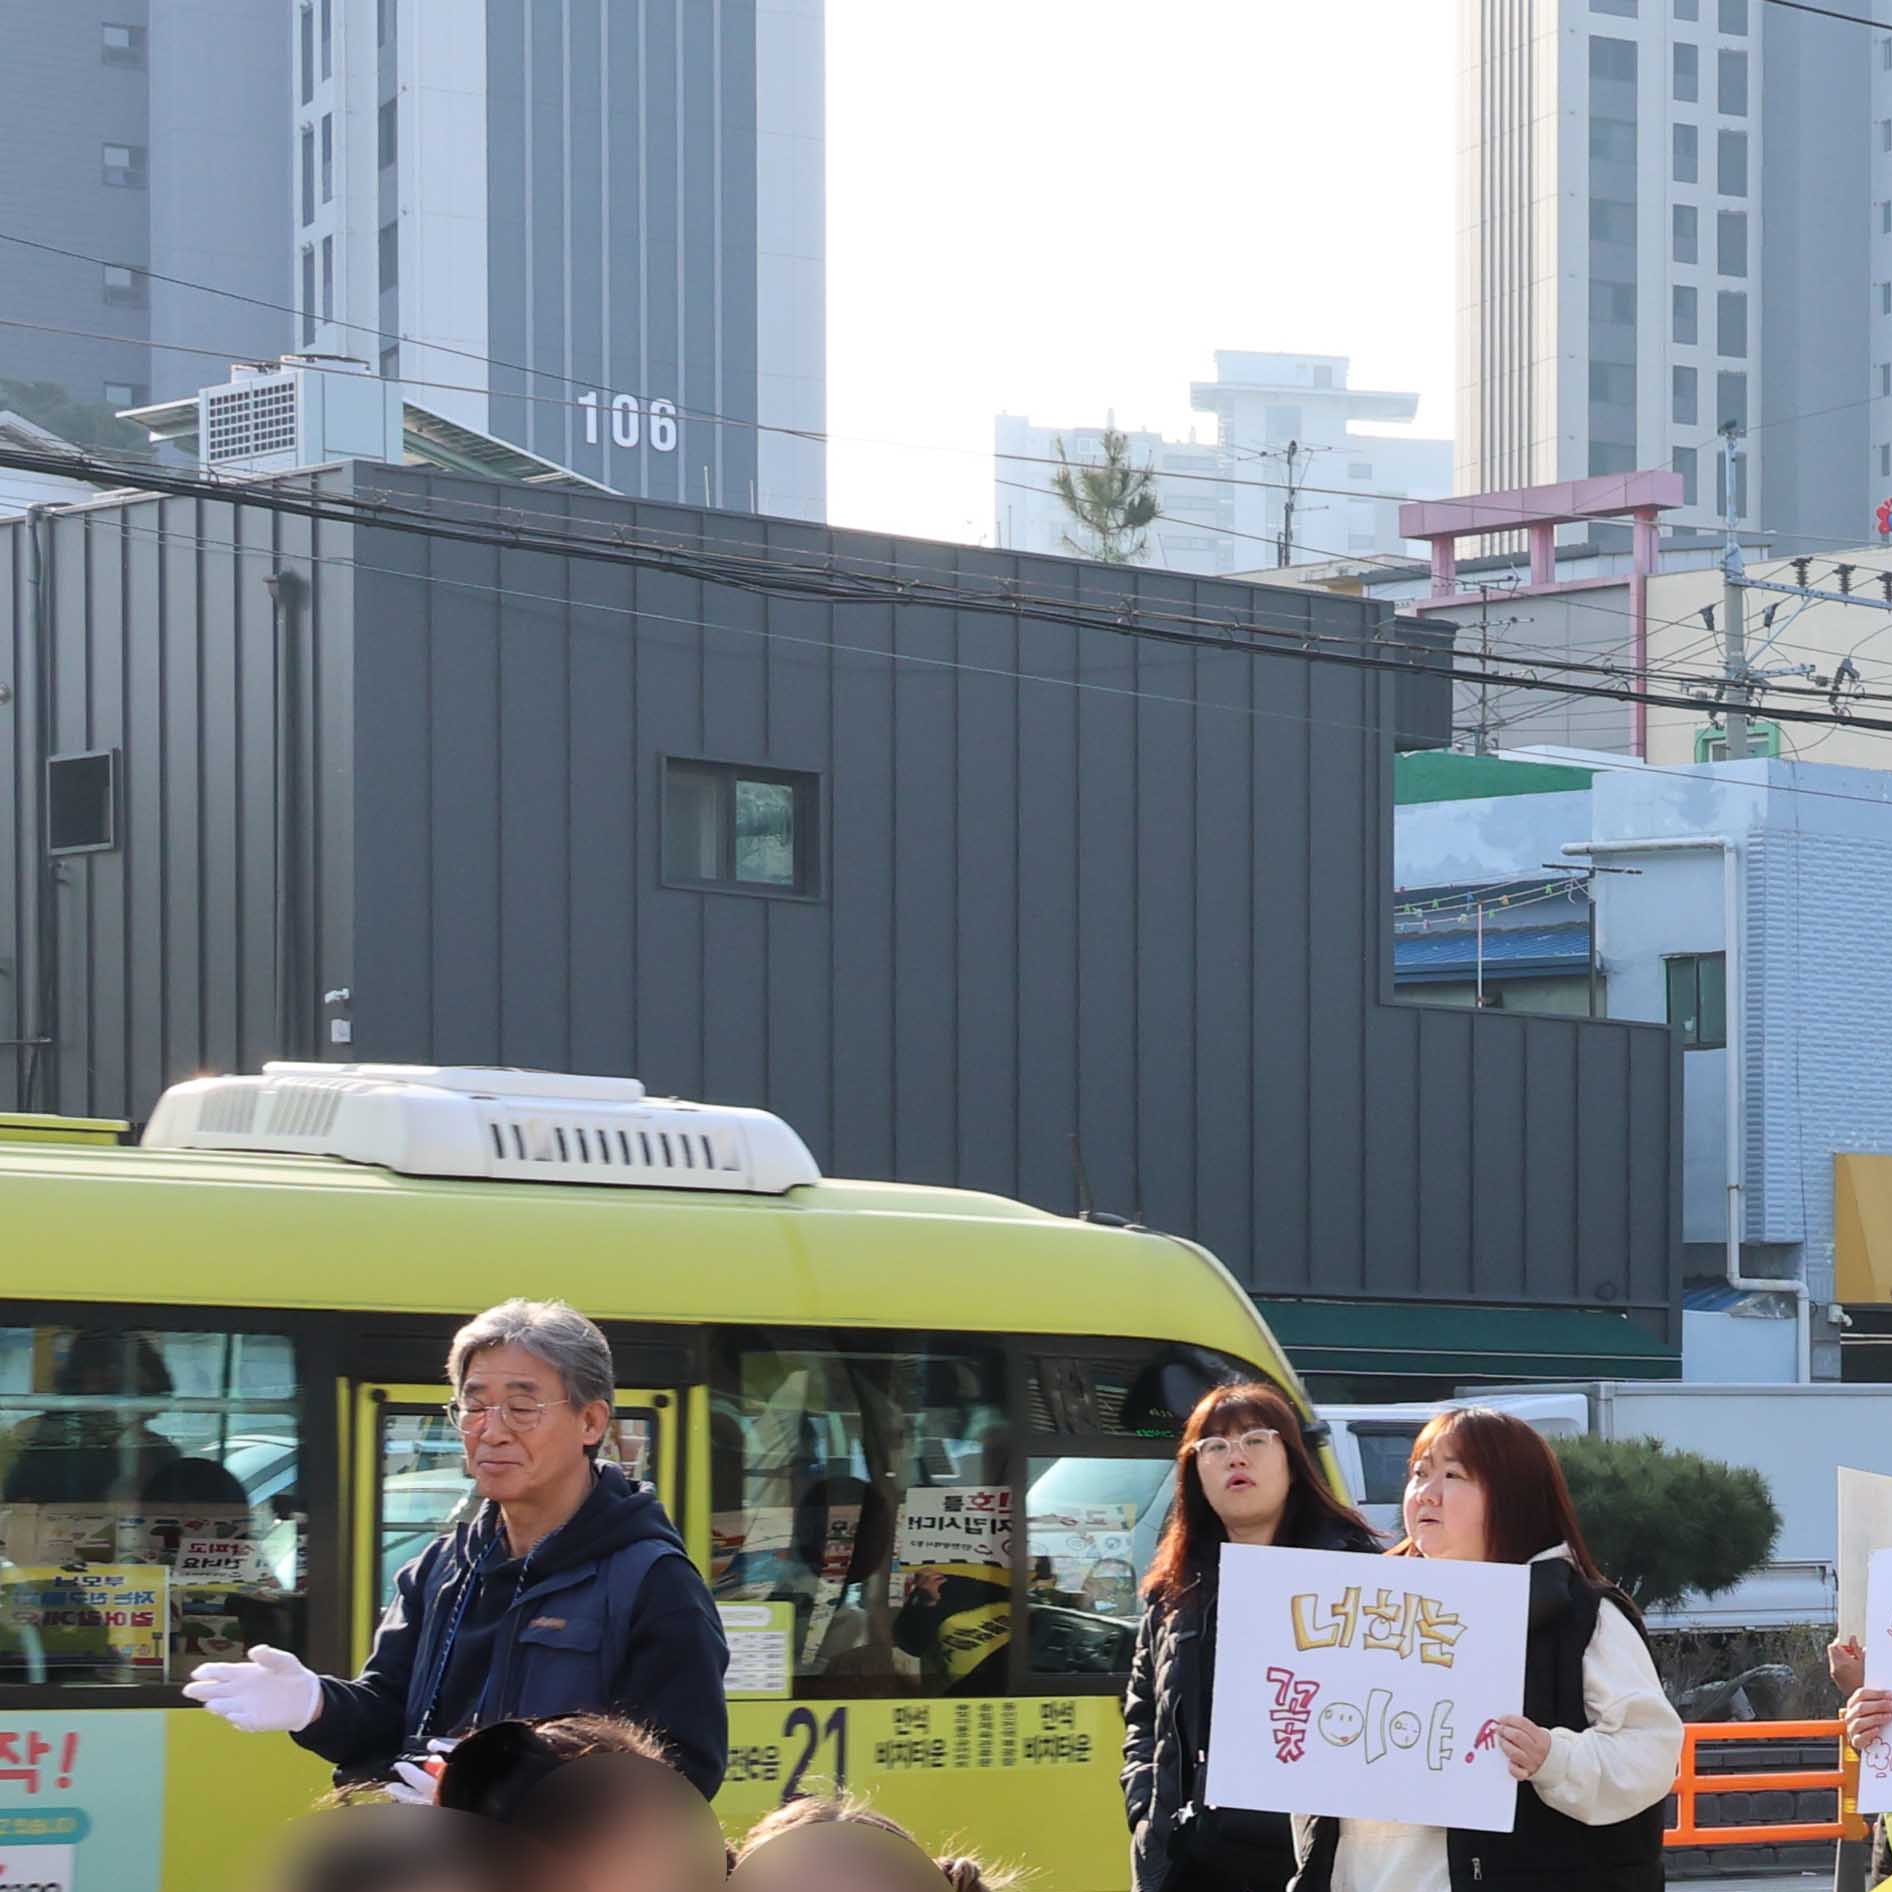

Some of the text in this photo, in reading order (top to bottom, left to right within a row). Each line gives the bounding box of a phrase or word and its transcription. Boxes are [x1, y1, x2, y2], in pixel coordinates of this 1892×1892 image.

[577, 390, 678, 452] 106
[1290, 1586, 1467, 1668] 너희는
[779, 1706, 848, 1807] 21
